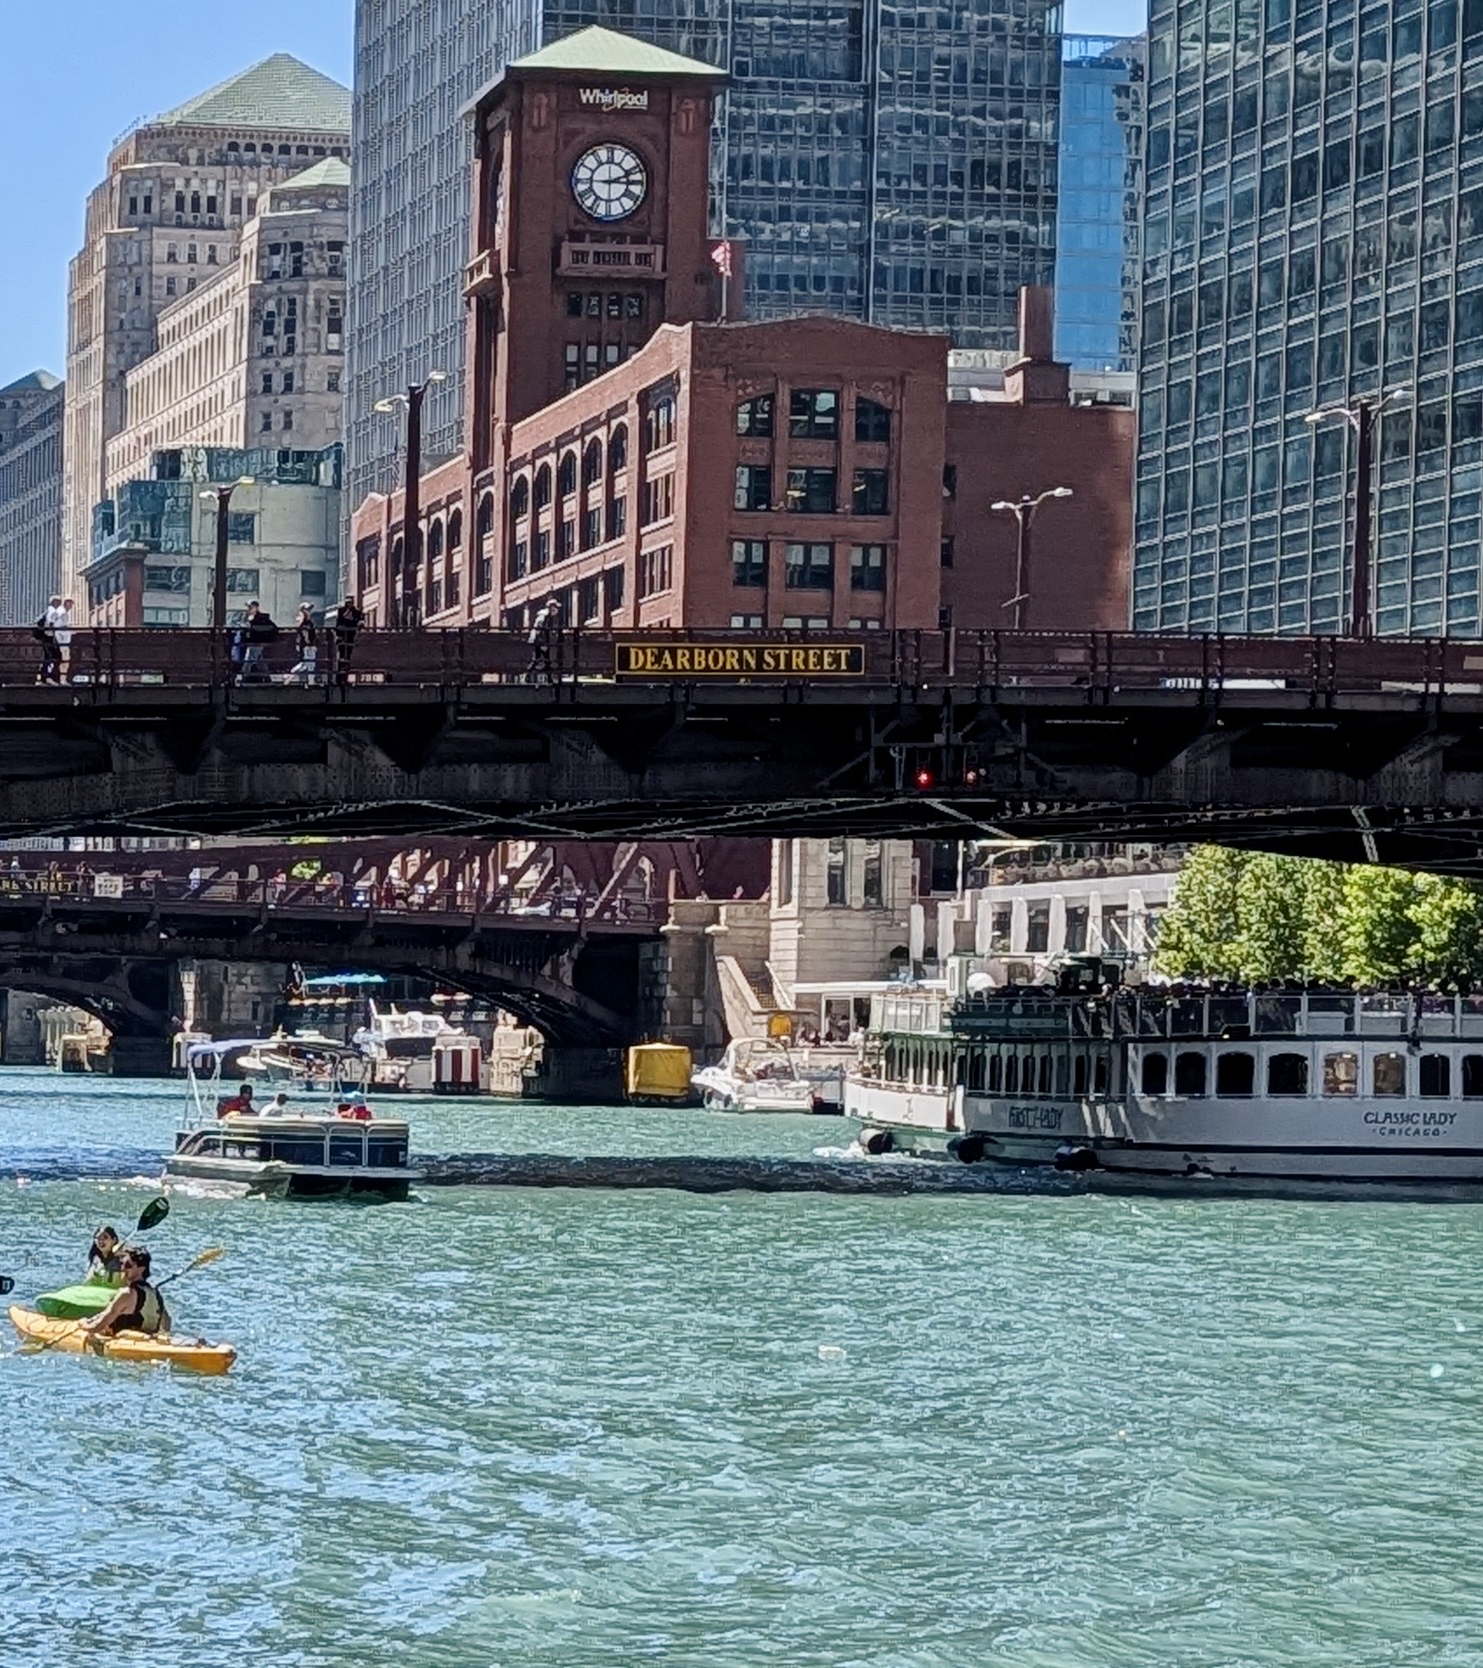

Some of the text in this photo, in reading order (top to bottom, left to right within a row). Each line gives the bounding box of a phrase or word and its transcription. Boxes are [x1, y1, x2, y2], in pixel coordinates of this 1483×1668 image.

[579, 88, 648, 110] Whirlpool
[629, 648, 850, 671] DEARBORN STREET
[1363, 1111, 1458, 1125] CLASSIC LADY
